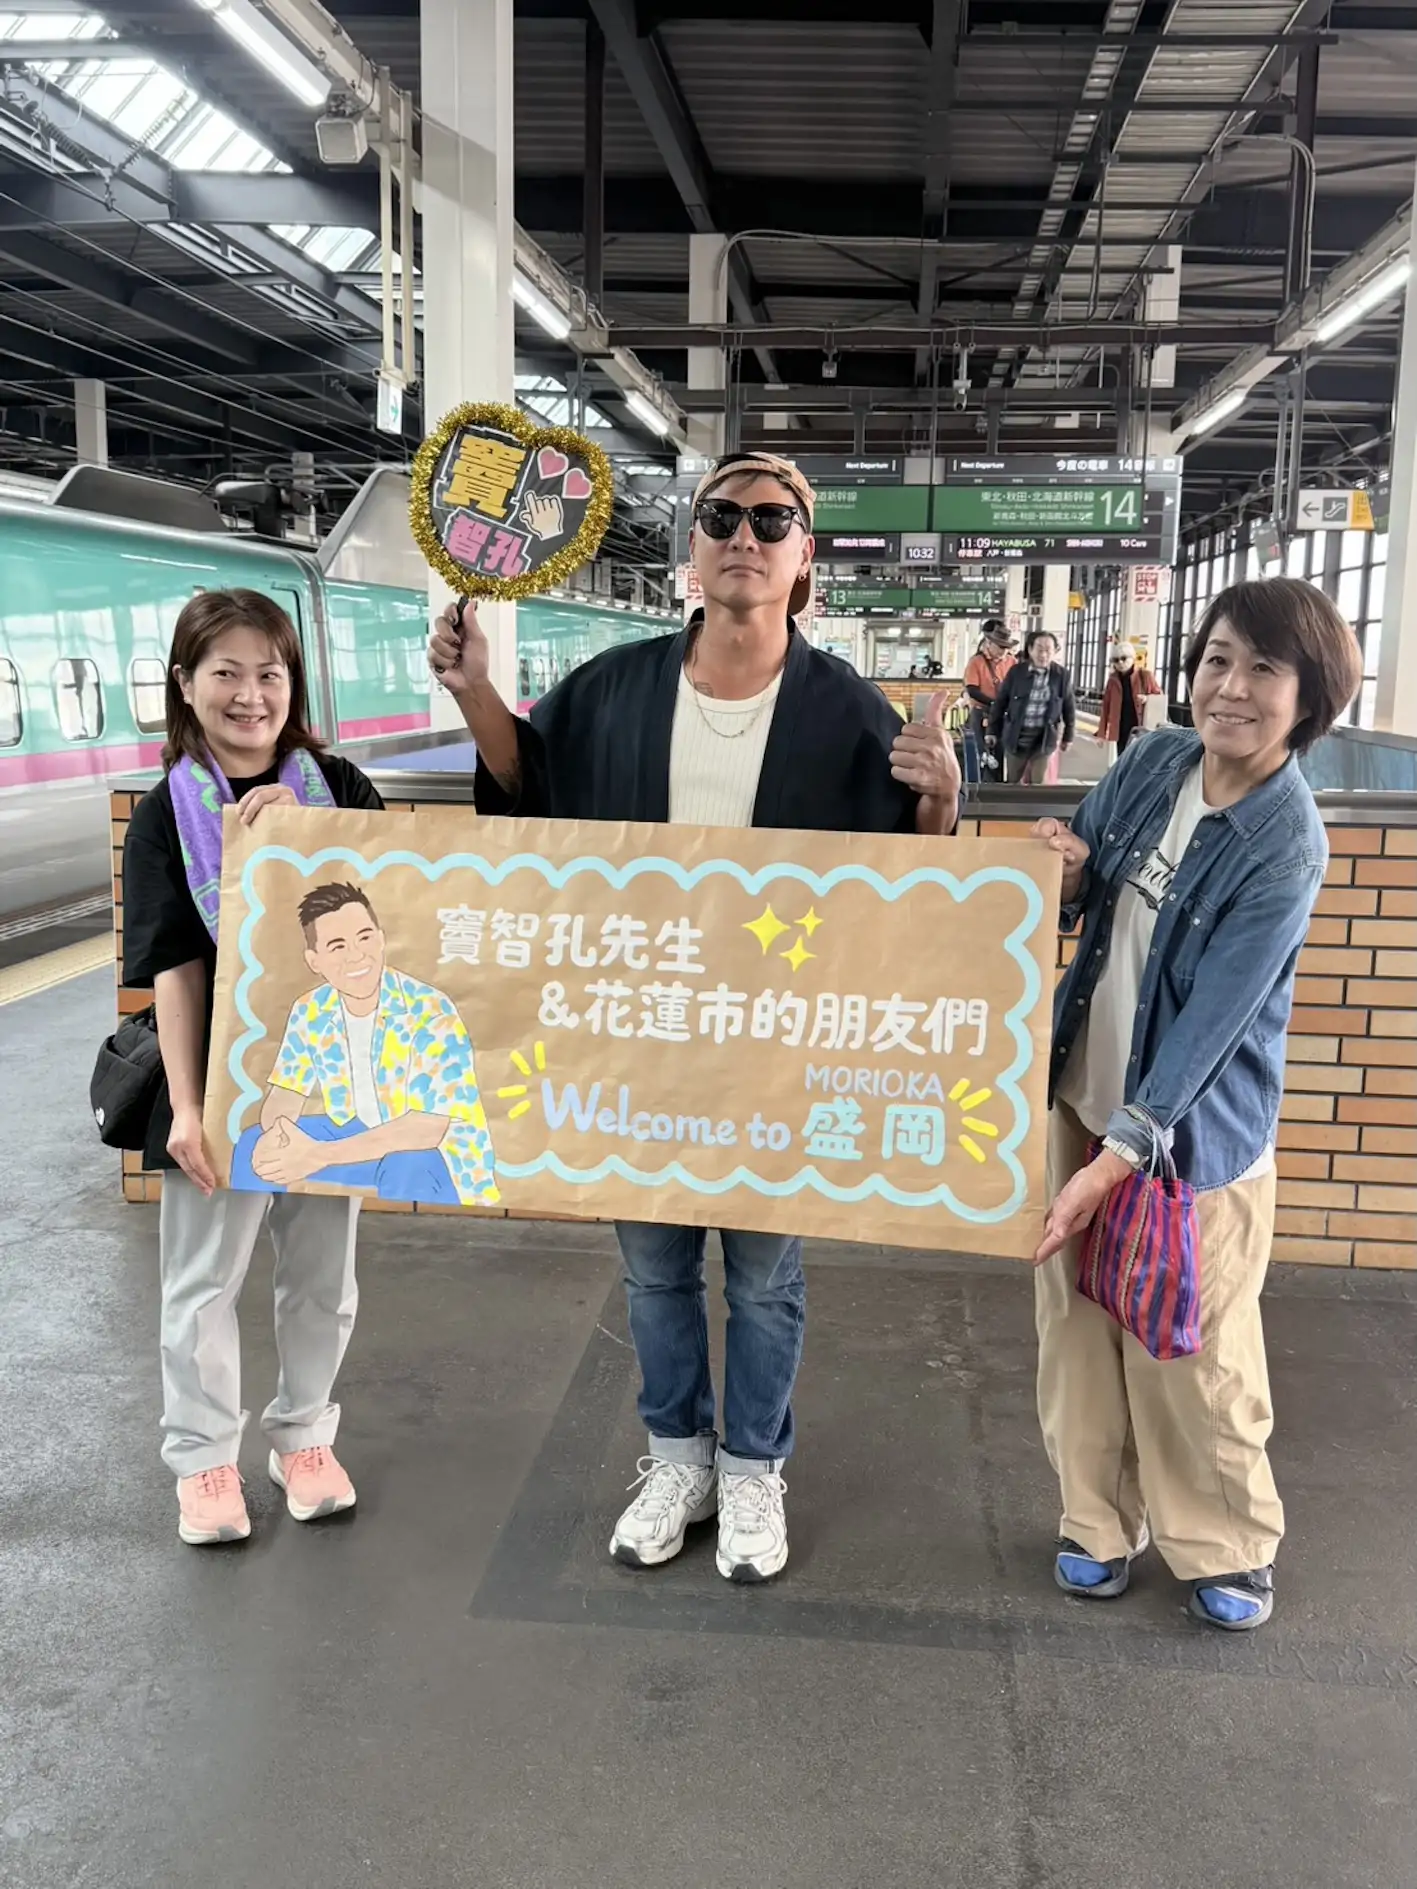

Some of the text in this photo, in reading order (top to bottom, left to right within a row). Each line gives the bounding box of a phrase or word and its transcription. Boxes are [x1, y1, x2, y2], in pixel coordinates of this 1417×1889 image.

[1100, 490, 1138, 526] 14
[445, 514, 525, 578] 智孔
[960, 537, 991, 548] 11:09
[992, 539, 1037, 547] HAYABUSA
[831, 589, 847, 605] 13
[977, 591, 993, 605] 14
[537, 978, 989, 1056] &花蓮市的朋友們
[804, 1062, 944, 1102] MORIOKA
[541, 1078, 738, 1146] Welcome
[745, 1112, 792, 1150] to
